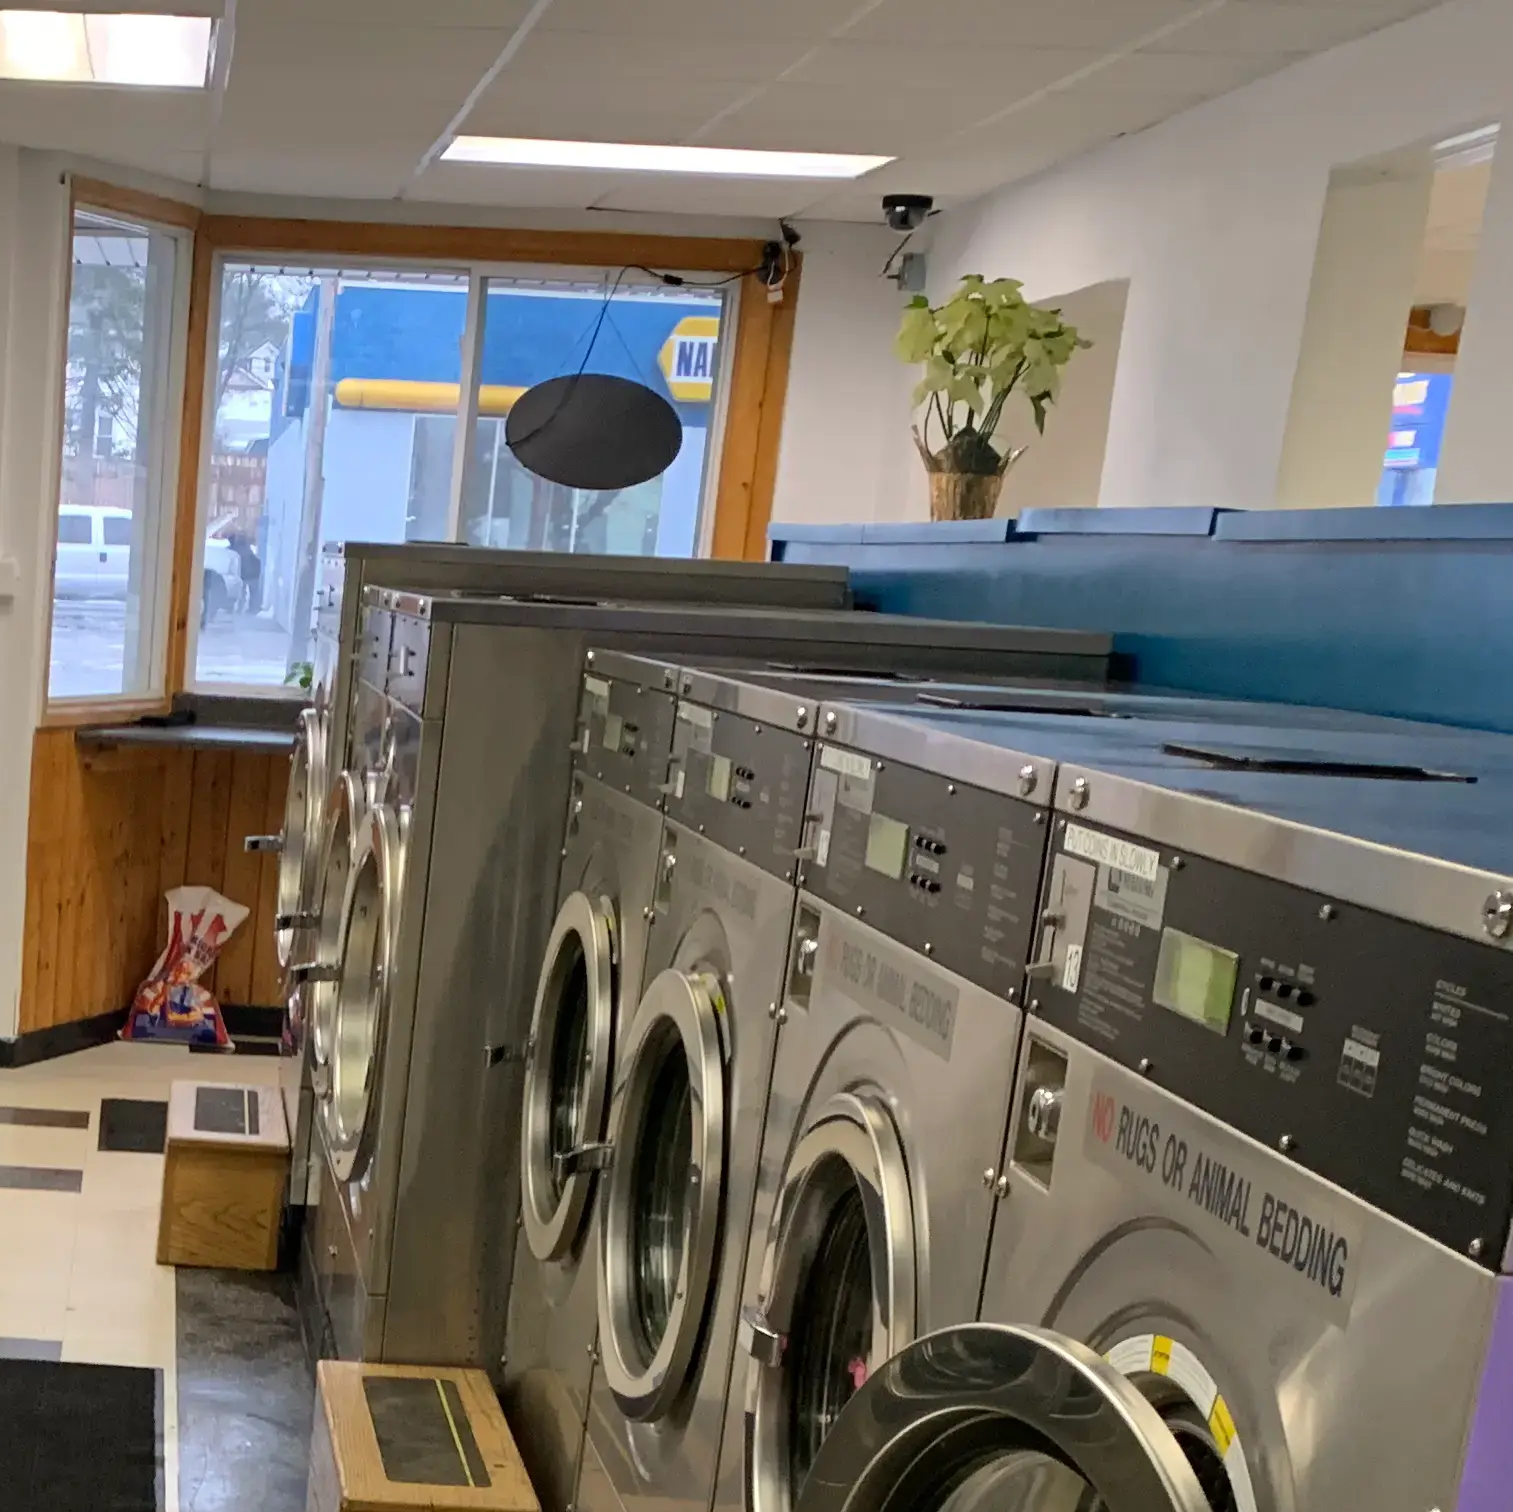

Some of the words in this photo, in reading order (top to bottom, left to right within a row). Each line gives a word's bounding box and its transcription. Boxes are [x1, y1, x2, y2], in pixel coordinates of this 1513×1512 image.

[1067, 949, 1080, 988] 13
[1092, 1091, 1116, 1144] NO
[1116, 1105, 1160, 1174] RUGS
[1162, 1133, 1187, 1192] OR
[1189, 1152, 1252, 1238] ANIMAL
[1256, 1192, 1348, 1298] BEDDING
